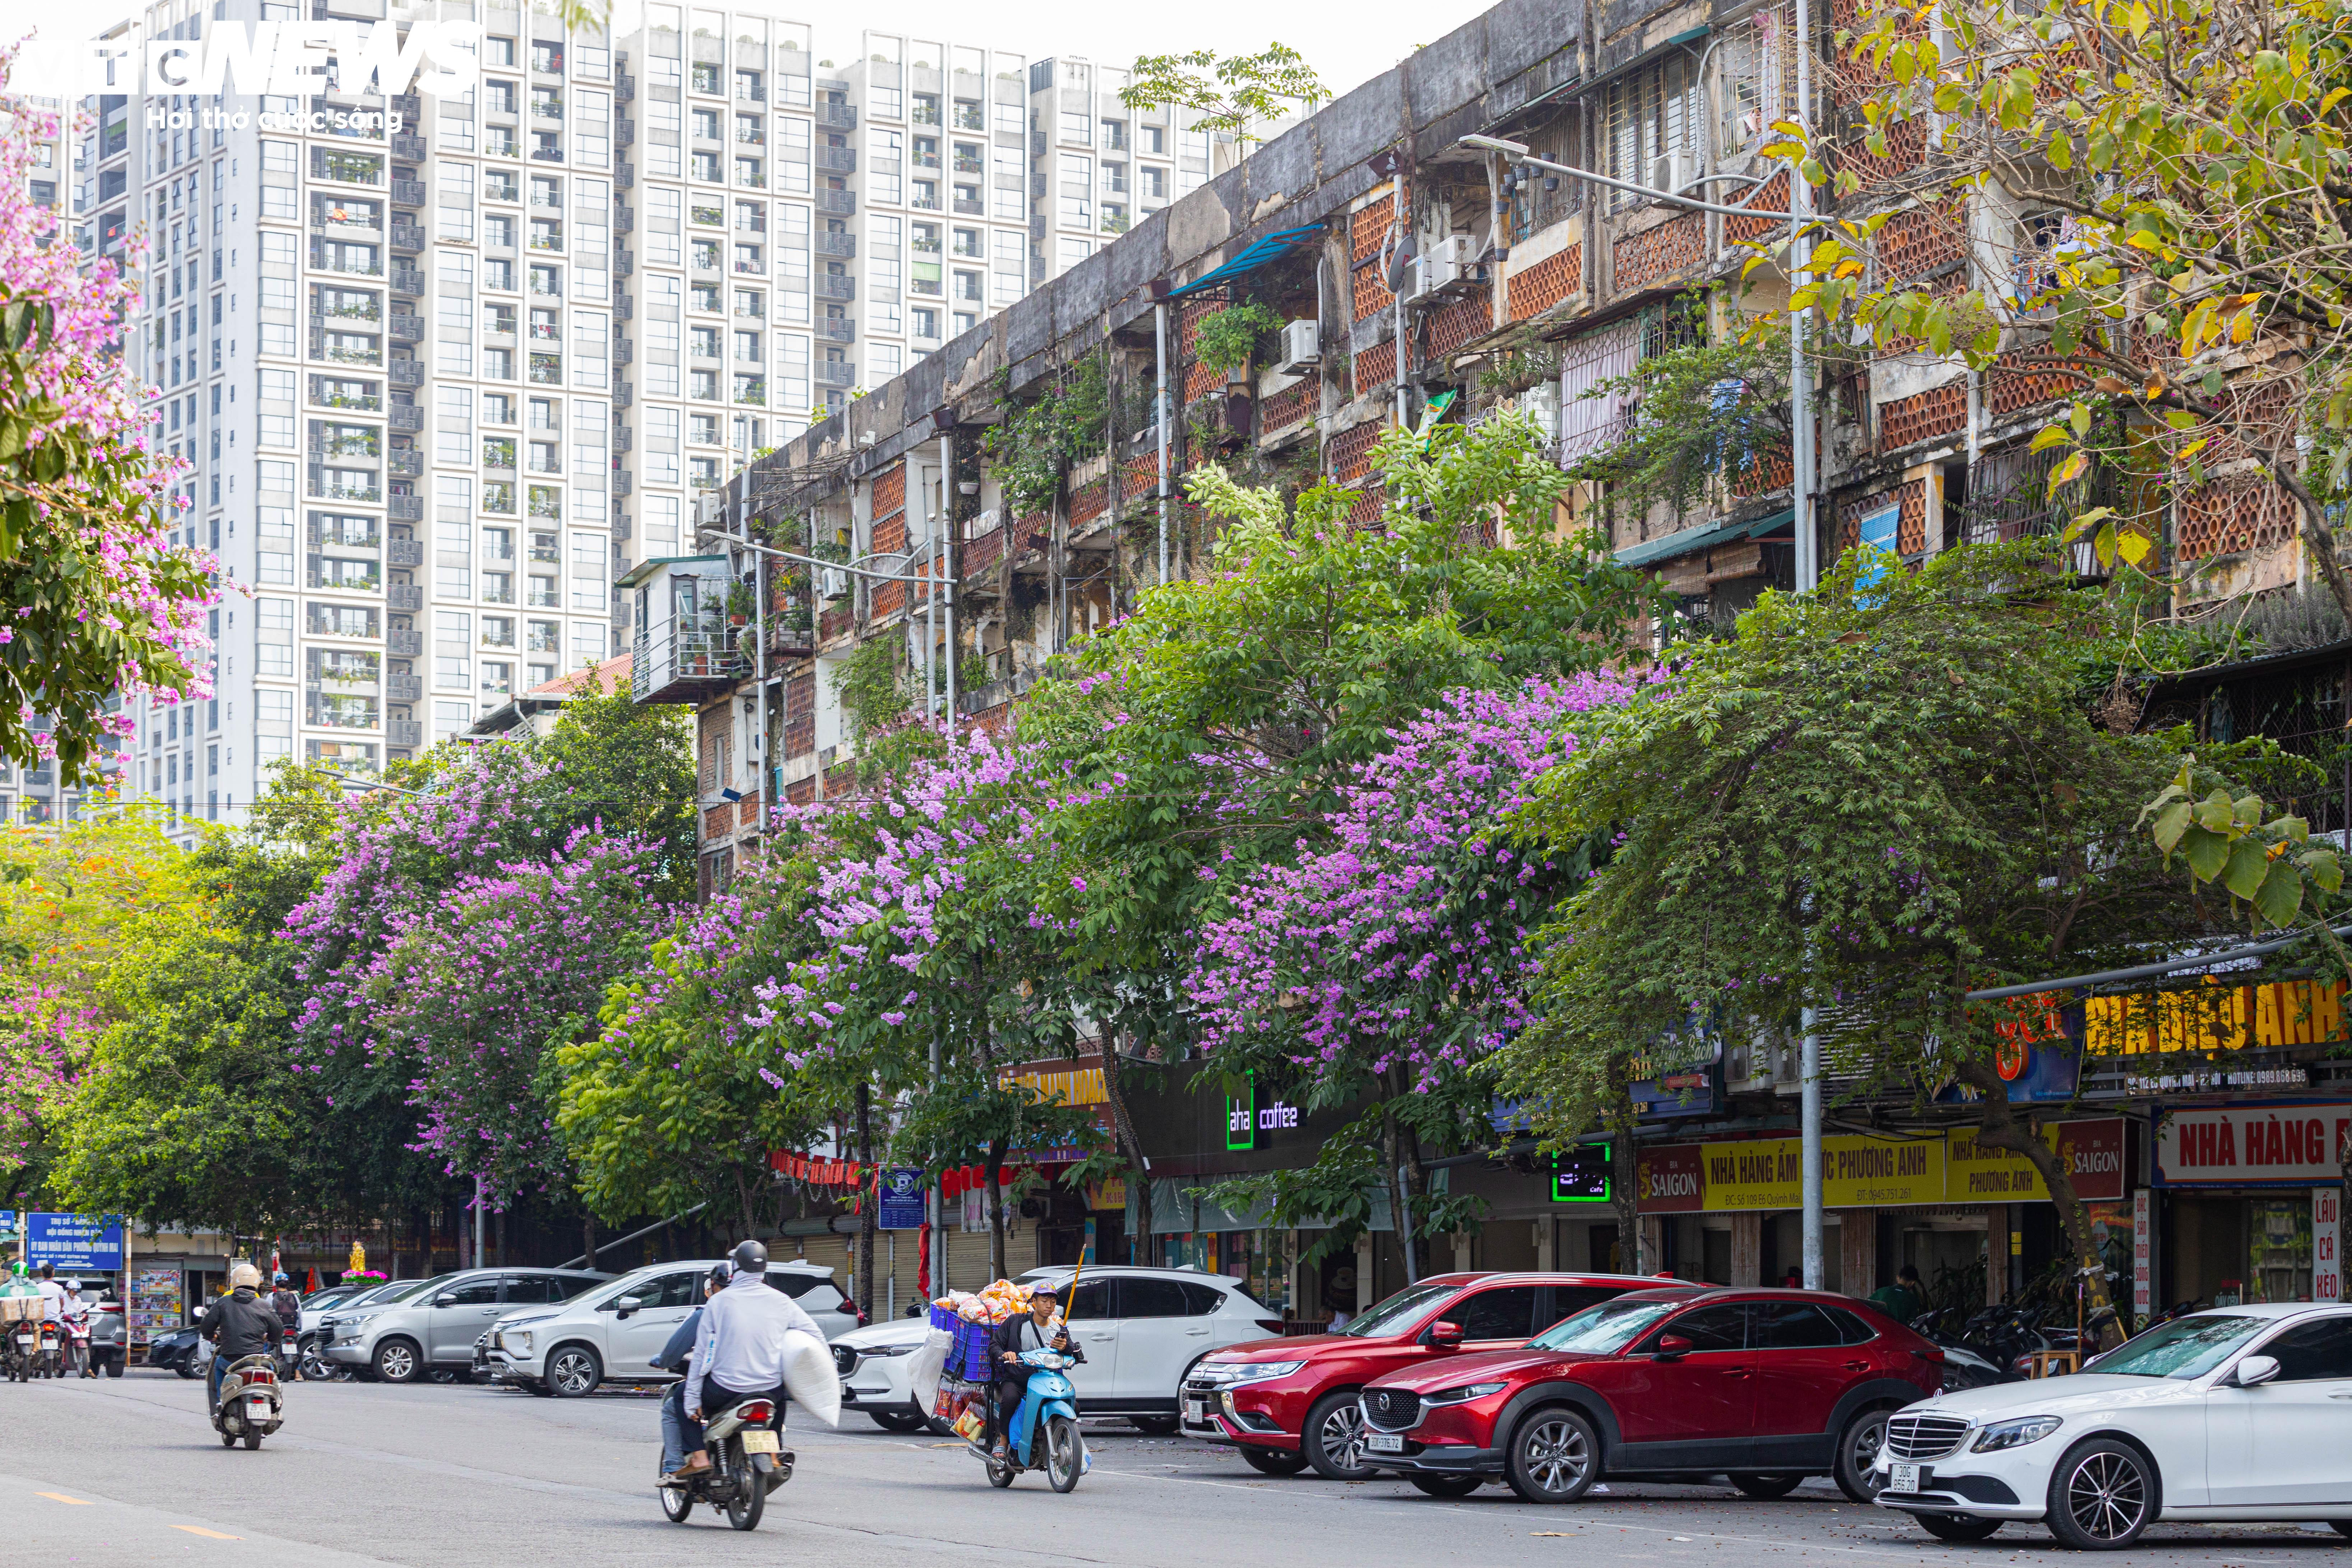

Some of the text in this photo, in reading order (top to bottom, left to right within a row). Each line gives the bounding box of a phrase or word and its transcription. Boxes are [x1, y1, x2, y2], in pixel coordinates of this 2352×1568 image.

[2256, 980, 2340, 1046] ANH
[1230, 1099, 1297, 1131] aha coffee
[1640, 1101, 1648, 1113] 261
[1953, 1136, 1972, 1161] NHÀ
[2180, 1115, 2236, 1166] NHÀ
[2245, 1114, 2324, 1165] HÀNG
[1711, 1151, 1736, 1185] NHÀ
[1740, 1150, 1773, 1184] HÀNG
[1777, 1142, 1797, 1182] ẨM
[1838, 1146, 1893, 1180] PHƯƠNG
[1898, 1145, 1926, 1177] ANH
[2075, 1151, 2118, 1173] SAIGON
[1652, 1173, 1697, 1196] SAIGON
[1969, 1169, 2033, 1192] PHƯƠNG ANH
[1725, 1195, 1736, 1205] ĐC:
[1737, 1193, 1745, 1205] Số
[1746, 1195, 1757, 1205] 109
[1759, 1194, 1766, 1205] E6
[1767, 1193, 1787, 1206] Quỳnh
[1857, 1188, 1911, 1201] ĐT: 0945.751.261
[2316, 1191, 2336, 1223] LẨU
[109, 1243, 118, 1252] MAI
[2319, 1231, 2333, 1260] CÁ
[2316, 1269, 2337, 1298] KÈO
[1899, 1466, 1911, 1477] 30G
[1894, 1479, 1915, 1491] 856.20
